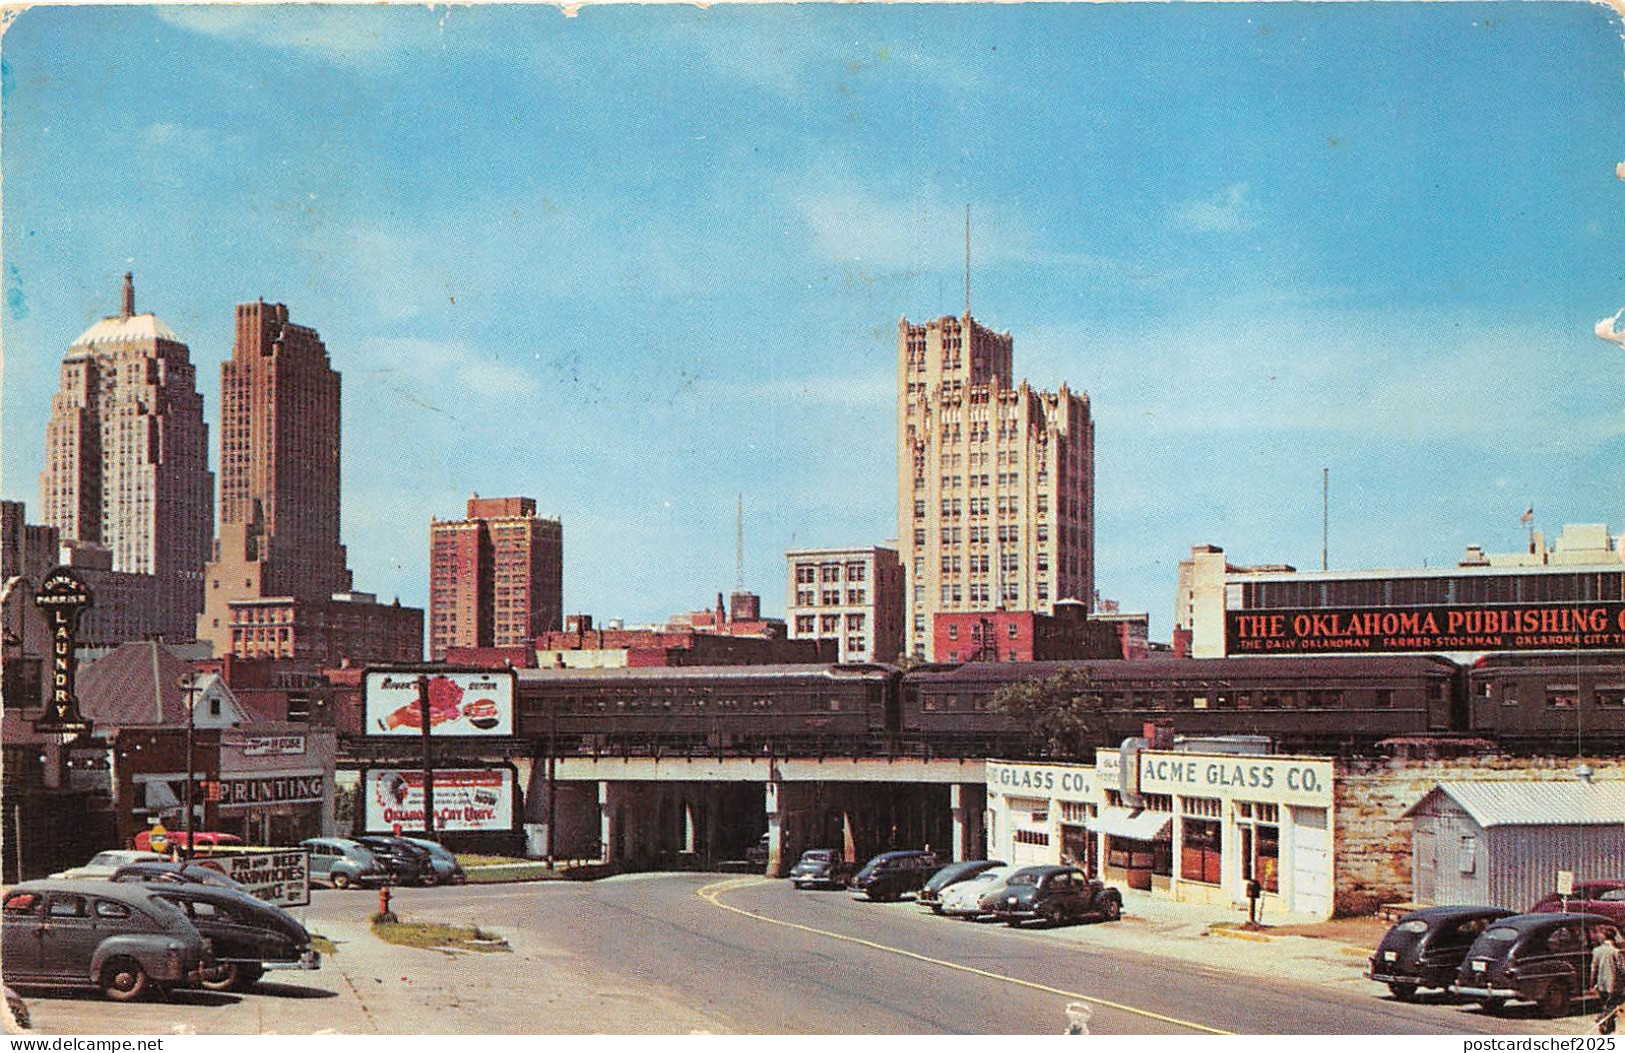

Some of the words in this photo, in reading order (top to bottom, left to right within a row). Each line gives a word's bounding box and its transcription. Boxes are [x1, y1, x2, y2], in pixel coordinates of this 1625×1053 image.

[1236, 615, 1285, 638] THE
[1294, 612, 1440, 637] OKLAHOMA
[1448, 608, 1608, 634] PUBLISHING
[1240, 639, 1262, 649] THE
[1266, 638, 1297, 649] DAILY
[1302, 638, 1370, 648] OKLAHOMAN
[1383, 636, 1501, 647] FARMER-STOCKMAN
[1516, 635, 1580, 646] OKLAHOMA
[1584, 634, 1609, 645] CITY
[56, 610, 68, 717] LAUNDRY
[1000, 769, 1054, 789] GLASS
[1144, 760, 1197, 782] ACME
[1206, 764, 1274, 788] GLASS
[1287, 767, 1322, 792] CO.
[219, 778, 322, 800] PRINTING
[383, 807, 438, 823] OKLAHOA
[440, 807, 462, 821] CITY
[272, 854, 303, 867] BEEF
[230, 866, 305, 884] SANDWICHES
